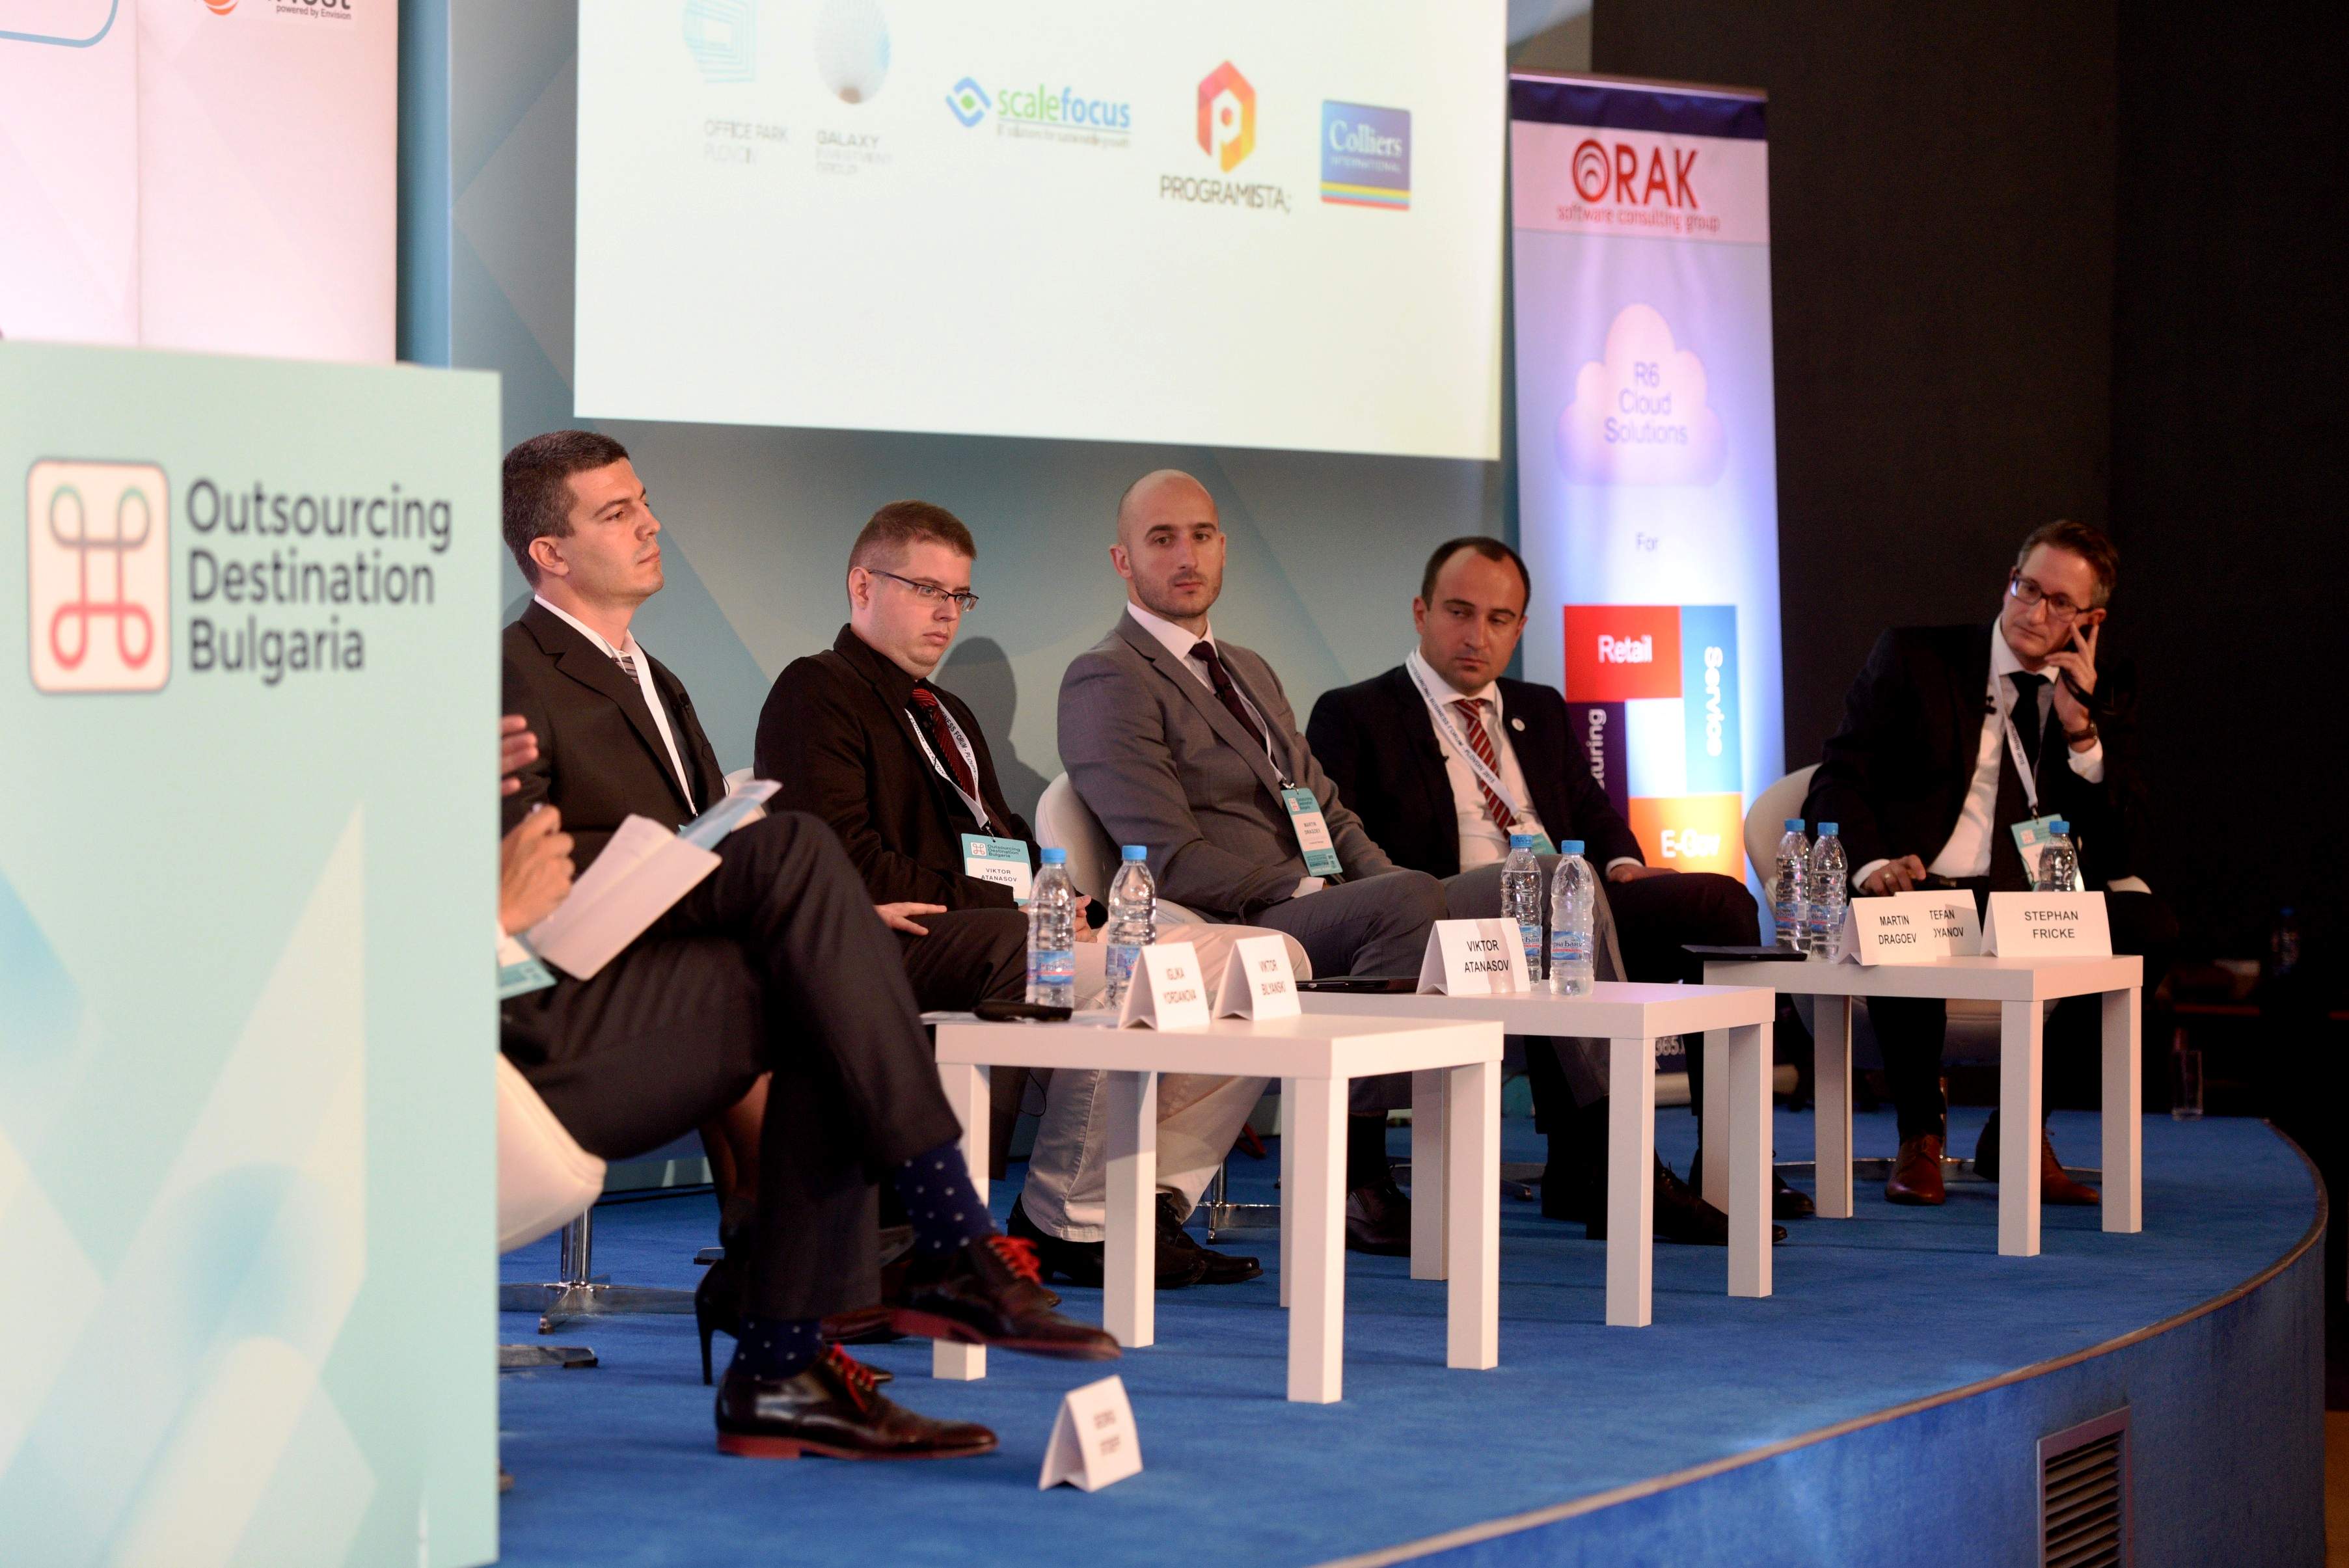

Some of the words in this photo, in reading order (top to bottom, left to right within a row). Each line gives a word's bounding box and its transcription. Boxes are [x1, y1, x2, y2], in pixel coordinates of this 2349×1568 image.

[276, 5, 308, 16] powered
[310, 8, 319, 18] by
[321, 8, 351, 20] Envision
[997, 83, 1131, 129] scalefocus
[816, 129, 880, 149] GALAXY
[1329, 118, 1403, 158] Colliers
[1571, 138, 1700, 210] ORAK
[1557, 204, 1613, 224] software
[1618, 206, 1682, 233] consulting
[1686, 213, 1720, 233] group
[1633, 362, 1660, 387] R6
[1618, 388, 1672, 415] Cloud
[1604, 417, 1689, 445] Solutions
[186, 478, 453, 554] Outsourcing
[1636, 534, 1658, 552] For
[189, 547, 435, 605] Destination
[189, 614, 365, 686] Bulgaria
[1598, 634, 1653, 664] Retail
[1704, 646, 1724, 757] Service
[953, 731, 968, 751] FORUM
[987, 844, 1021, 853] Outsourcing
[1879, 915, 1910, 926] MARTIN
[1929, 910, 1955, 920] TEFAN
[2024, 910, 2079, 921] STEPHAN
[1878, 933, 1917, 945] DRAGOEV
[2032, 928, 2076, 939] FRICKE
[1466, 939, 1500, 952] VIKTOR
[1464, 959, 1509, 973] ATANASOV
